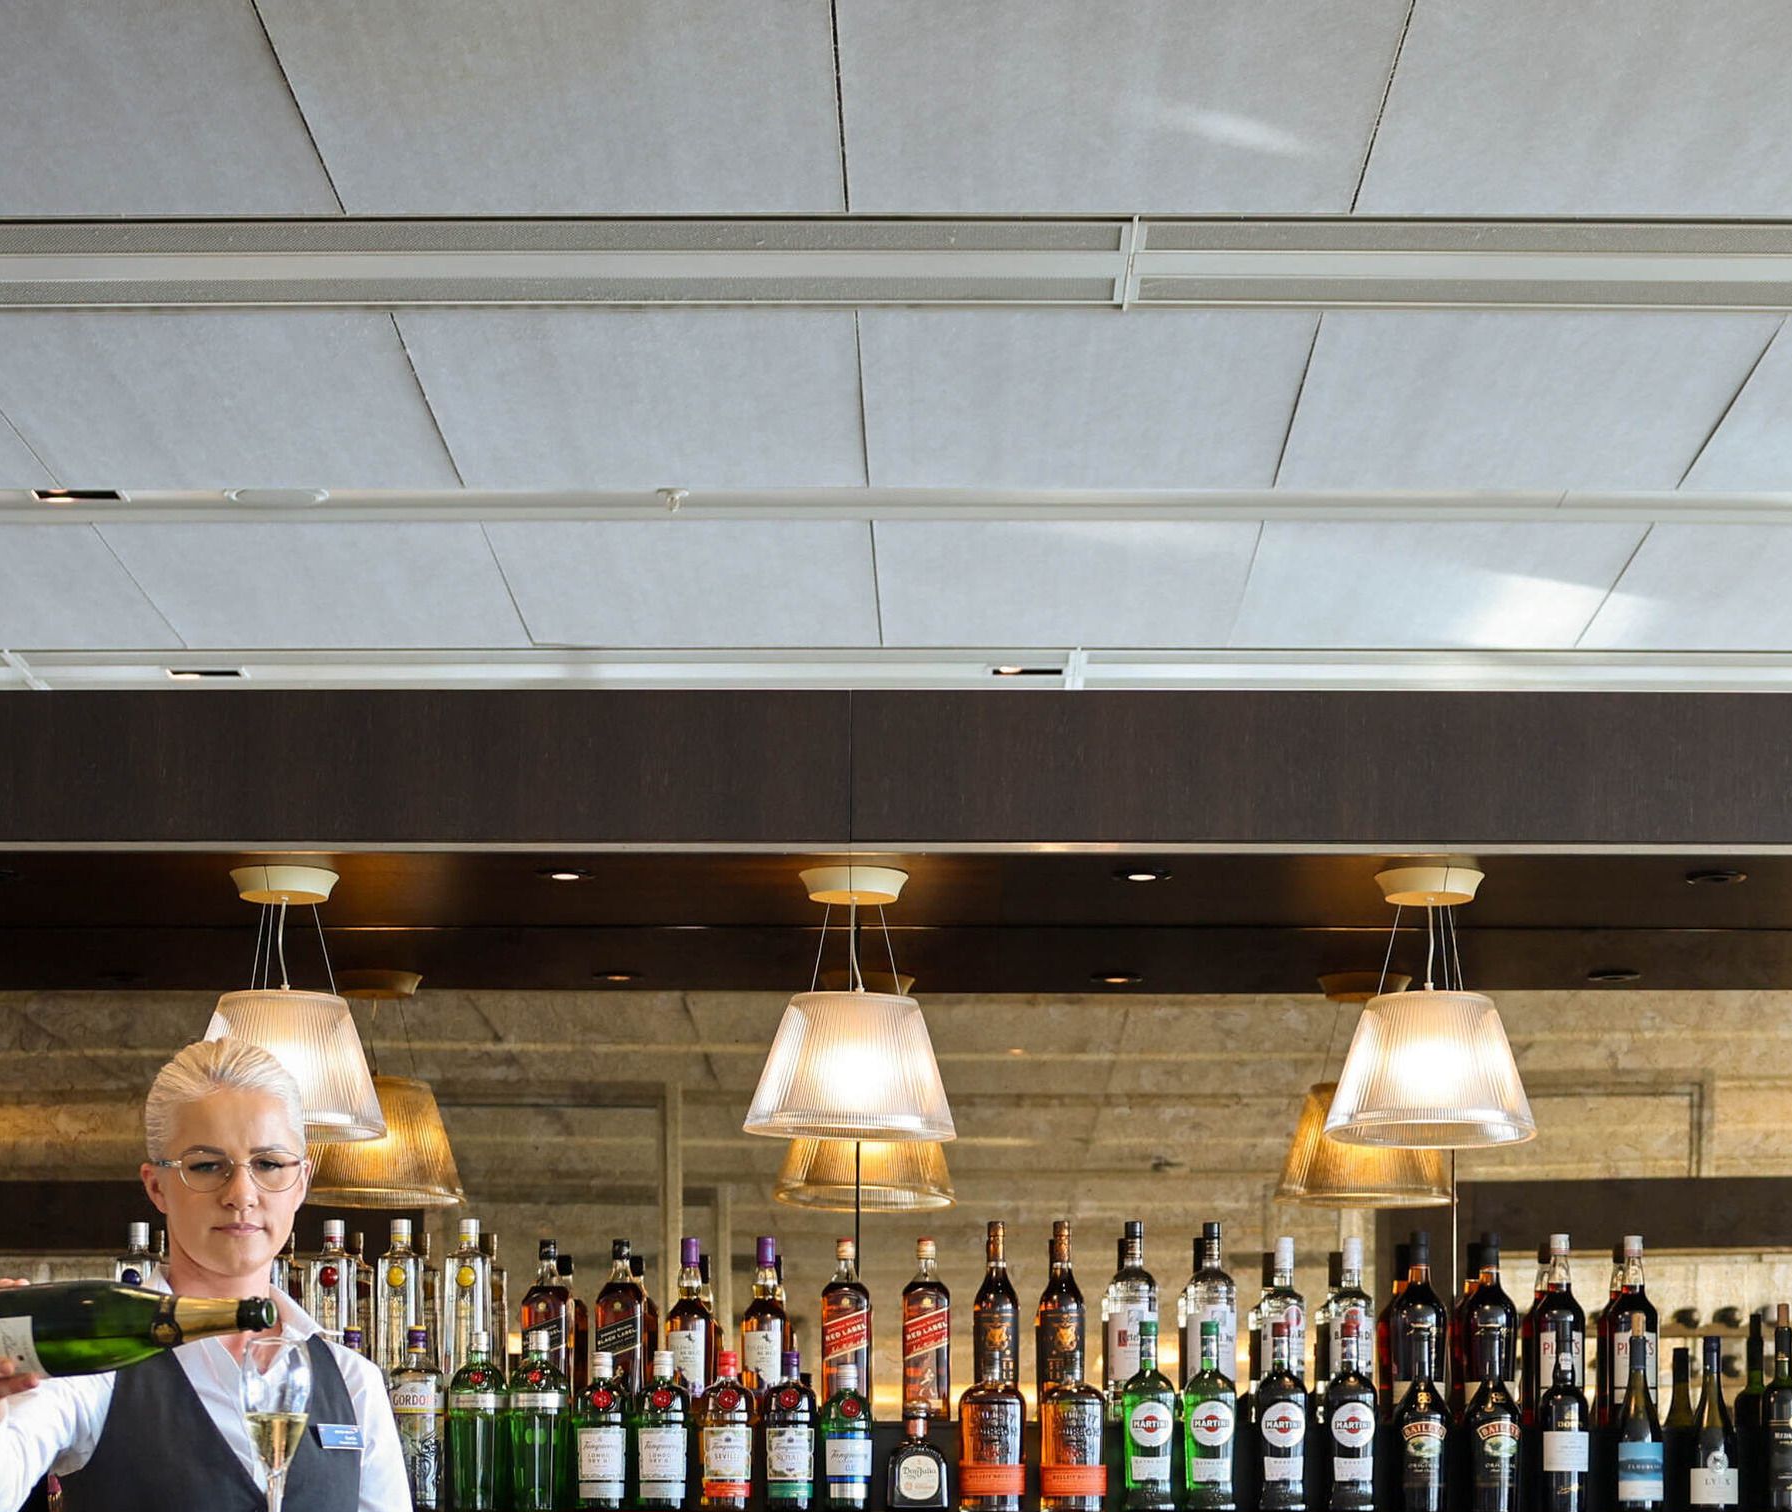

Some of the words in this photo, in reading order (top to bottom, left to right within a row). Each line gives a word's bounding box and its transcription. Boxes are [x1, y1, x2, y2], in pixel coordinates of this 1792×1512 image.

[842, 1323, 867, 1336] LABEL
[922, 1321, 948, 1335] LABEL
[1133, 1420, 1167, 1429] MARTINI
[1194, 1420, 1229, 1429] MARTINI
[1266, 1420, 1302, 1429] MARTINI
[1335, 1421, 1371, 1430] MARTINI
[1405, 1423, 1444, 1437] BAILEYS
[1481, 1423, 1519, 1437] BAILYS
